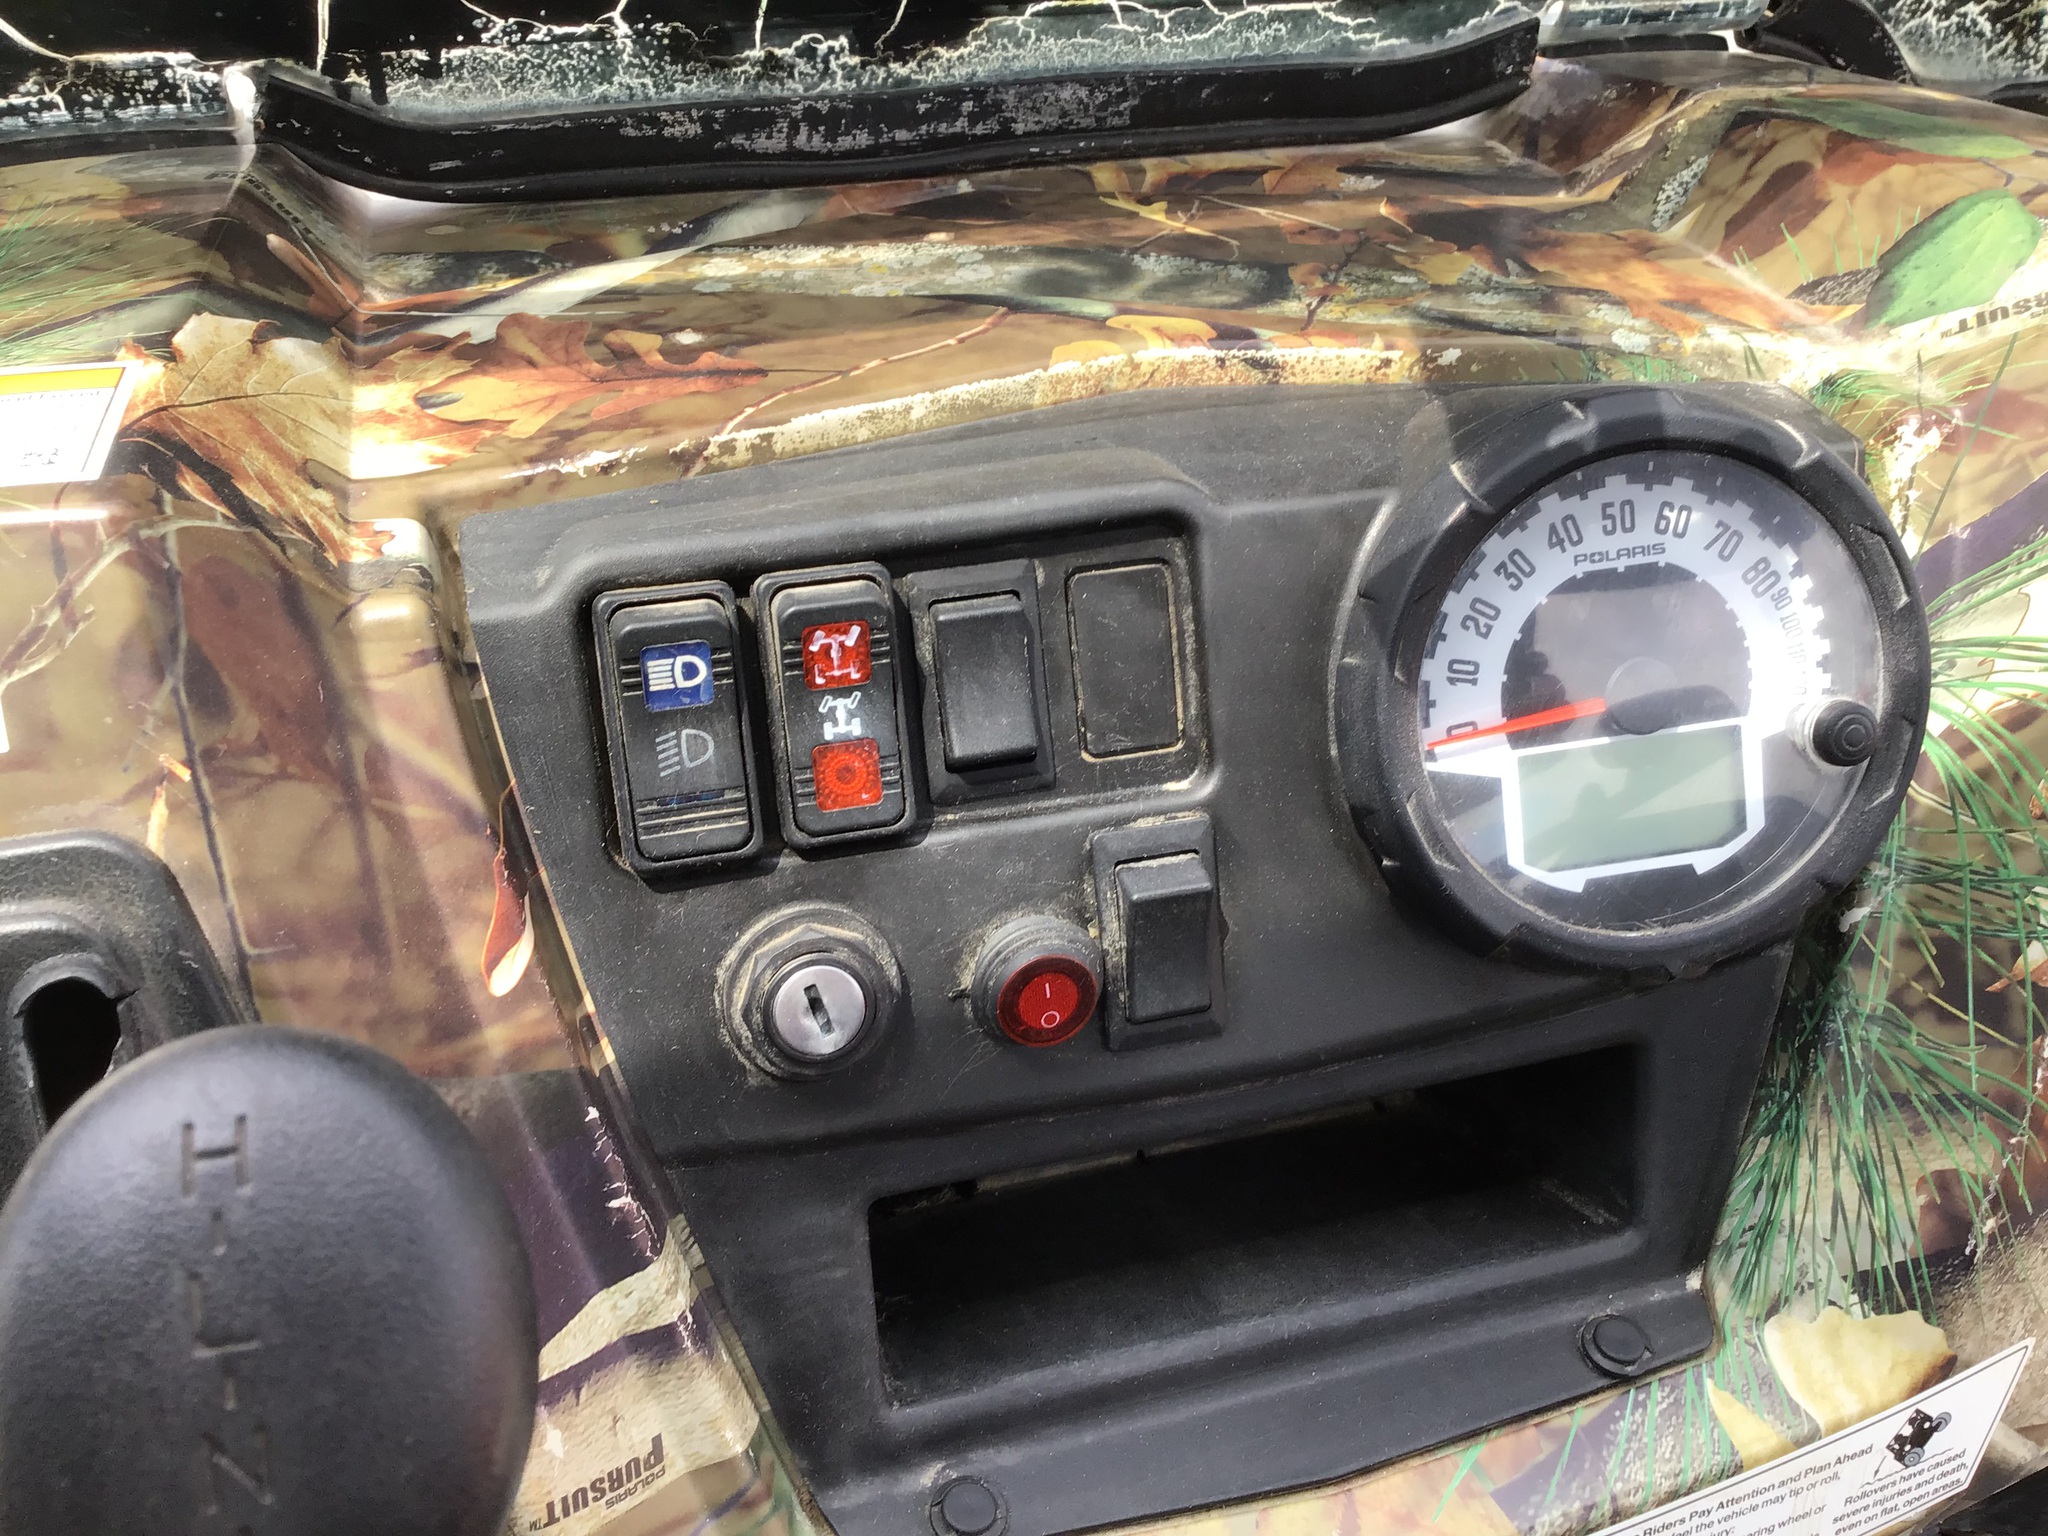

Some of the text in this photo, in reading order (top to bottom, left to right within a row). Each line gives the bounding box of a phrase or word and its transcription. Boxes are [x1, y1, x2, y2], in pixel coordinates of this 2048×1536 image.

[1547, 513, 1584, 554] 40
[1601, 499, 1636, 536] 50
[1654, 500, 1693, 539] 60
[1573, 542, 1666, 567] POLARIS
[1702, 519, 1744, 562] 70
[1493, 548, 1537, 592] 30
[1741, 556, 1782, 599] 80
[1460, 597, 1501, 640] 20
[1770, 586, 1793, 611] 90
[1779, 612, 1803, 639] 100
[1446, 658, 1480, 687] 10
[180, 1112, 252, 1199] H
[187, 1270, 262, 1358] L
[605, 1464, 666, 1510] POLARIS
[1643, 1444, 1874, 1536] Riders Pay Attention and Plan Ahead
[1832, 1461, 1969, 1525] severe injuries and death,
[1843, 1448, 1967, 1508] Rollovers have caused
[1695, 1520, 1715, 1535] the
[1717, 1503, 1759, 1526] vehicle
[1761, 1493, 1787, 1509] may
[1789, 1487, 1804, 1499] tip
[1806, 1482, 1819, 1493] or
[1820, 1471, 1841, 1487] roll,
[1778, 1507, 1813, 1529] wheel
[1813, 1504, 1827, 1515] or
[1834, 1478, 1963, 1536] even on flat, open areas.
